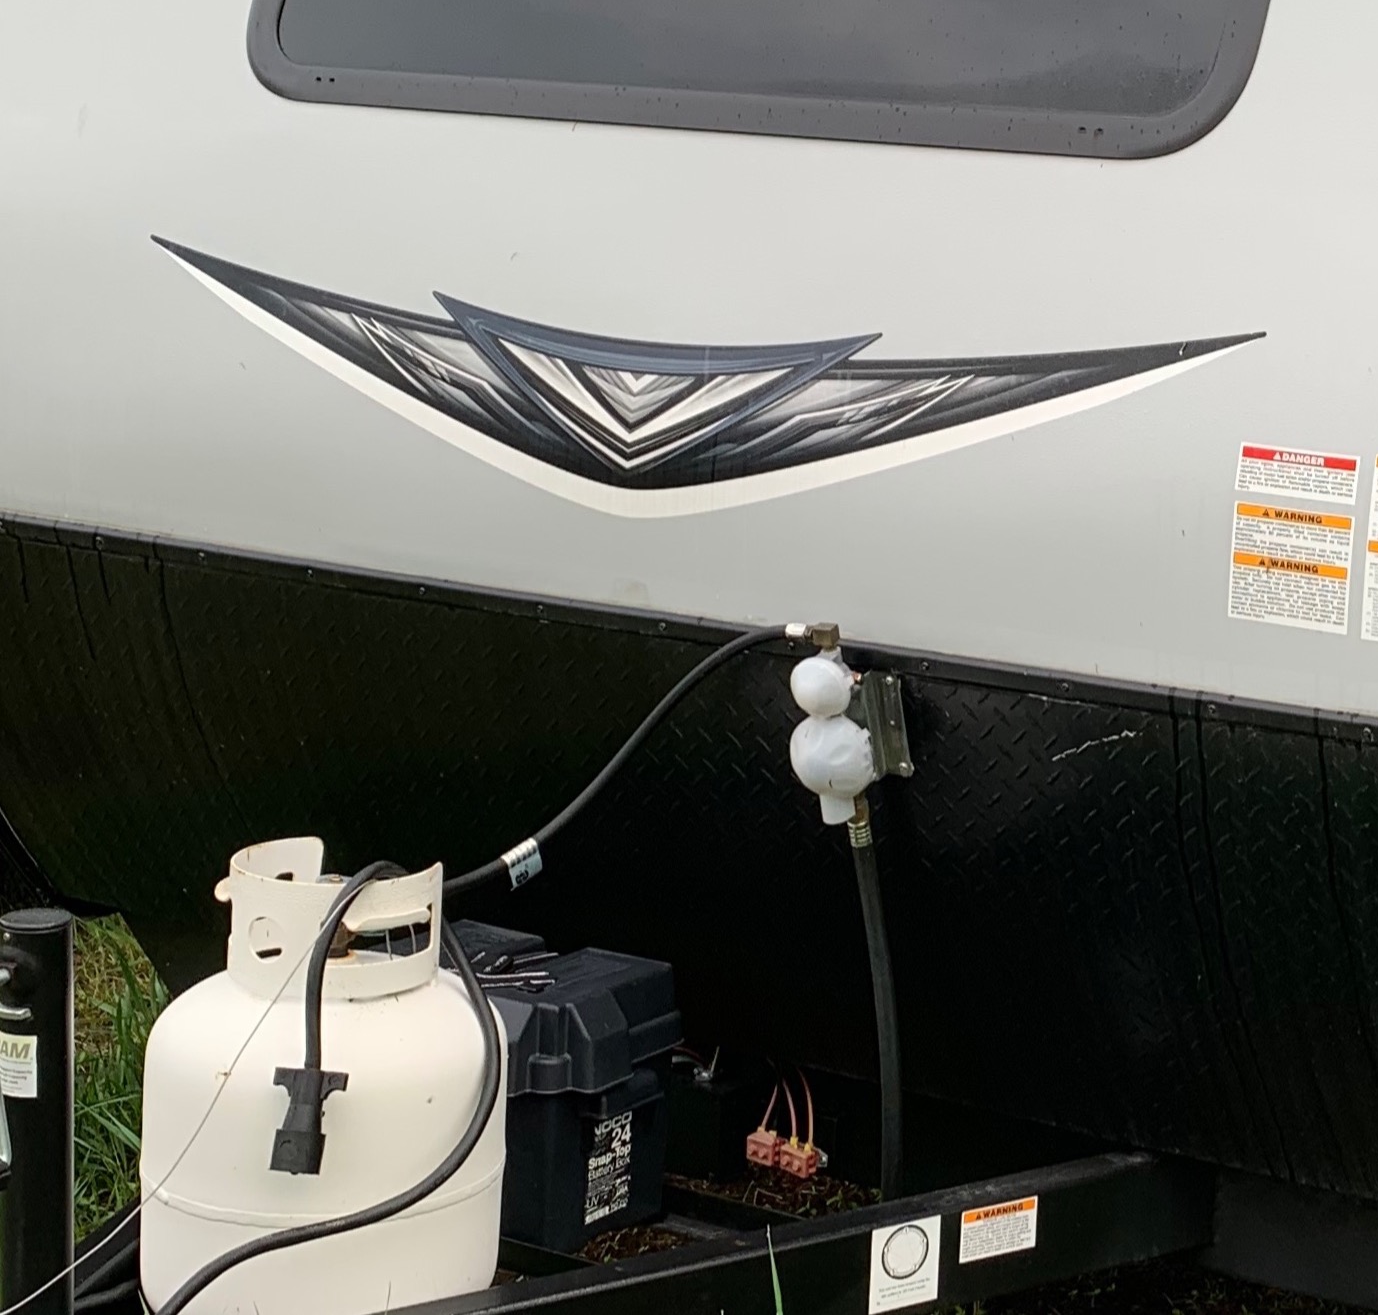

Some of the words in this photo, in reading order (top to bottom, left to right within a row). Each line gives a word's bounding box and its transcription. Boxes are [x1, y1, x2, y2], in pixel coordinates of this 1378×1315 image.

[1281, 452, 1325, 466] DANGER
[1274, 510, 1322, 524] WARNING
[1270, 558, 1319, 574] WARNING
[611, 1122, 631, 1149] 24
[588, 1144, 631, 1170] Snap-Top
[983, 1202, 1024, 1219] WARNING
